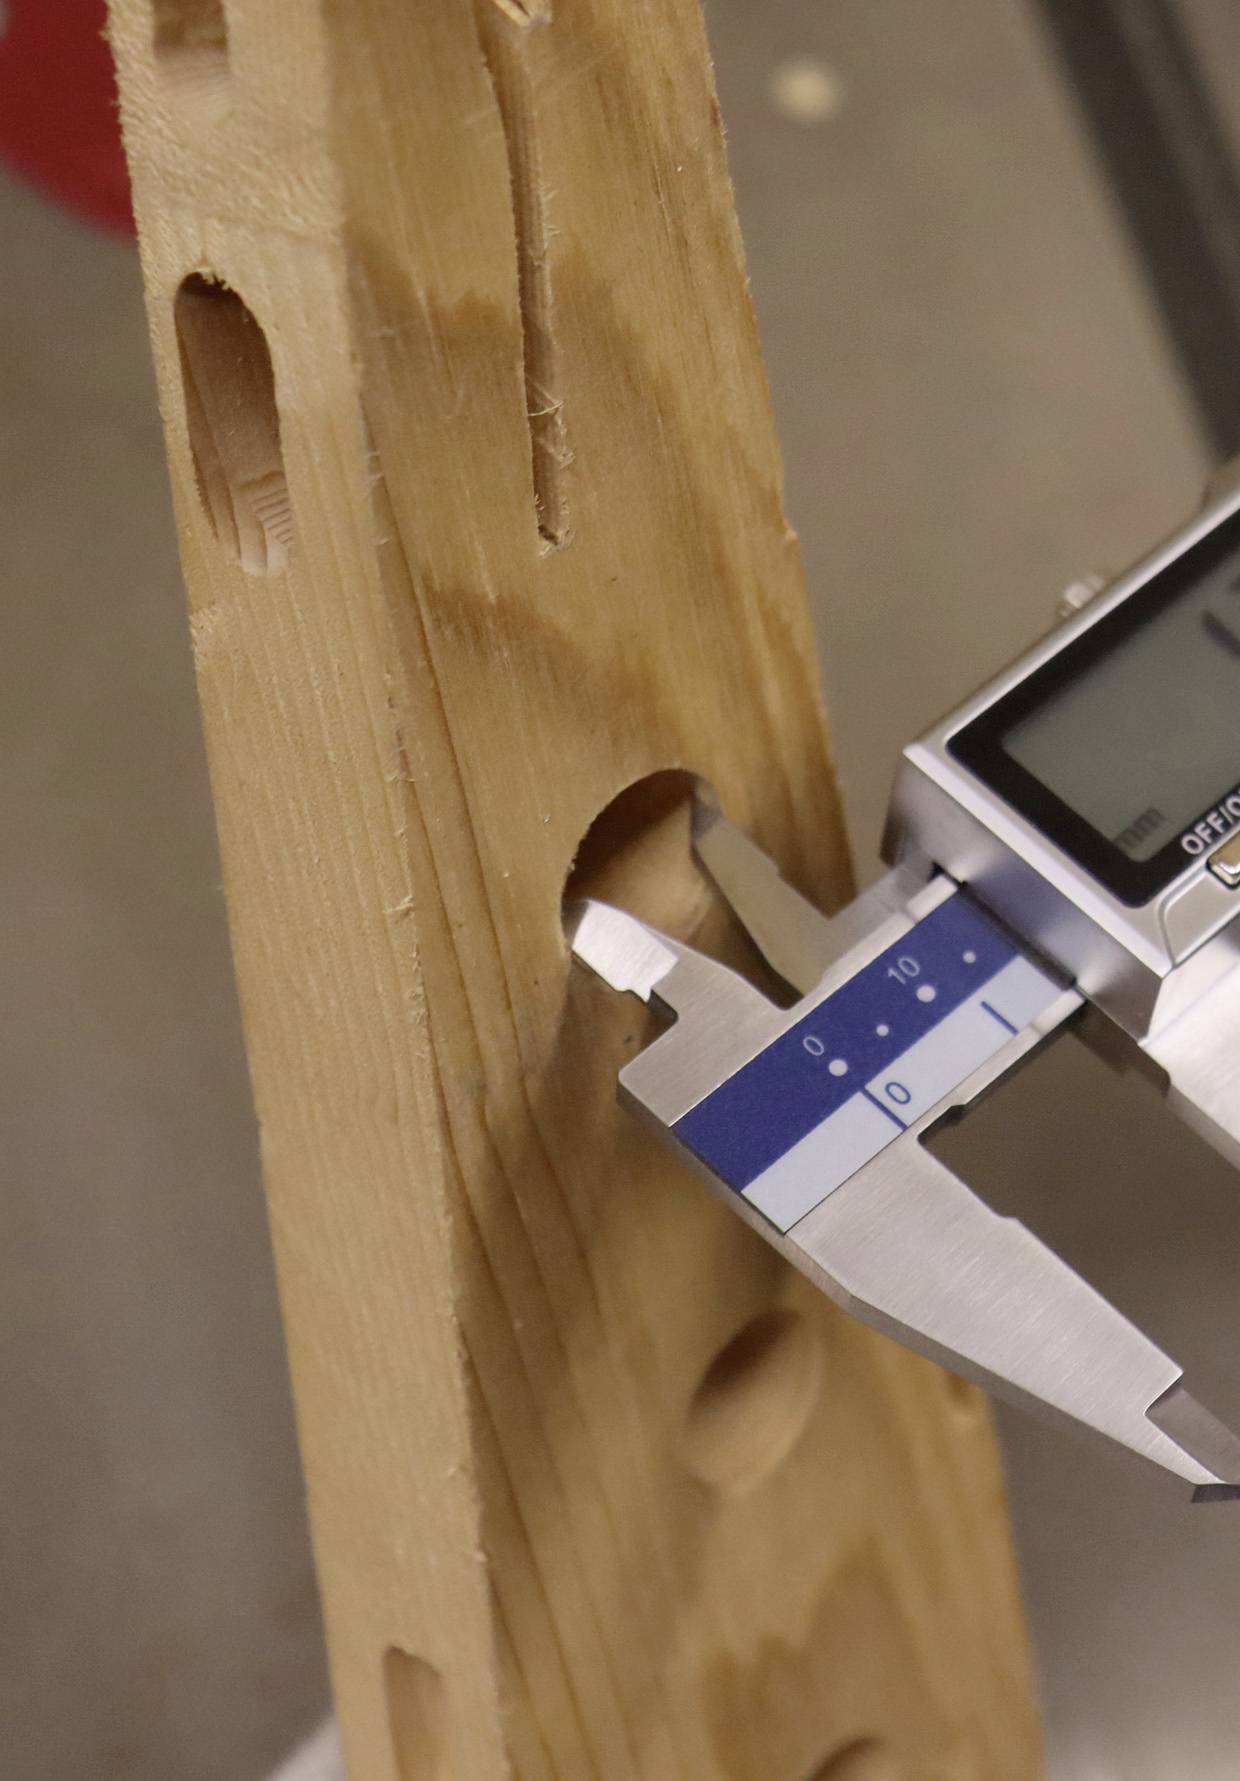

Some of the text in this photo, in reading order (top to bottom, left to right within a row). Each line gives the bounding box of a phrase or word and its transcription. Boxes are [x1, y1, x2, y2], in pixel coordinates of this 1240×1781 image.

[803, 956, 921, 1056] 0 10
[885, 1082, 911, 1105] 0
